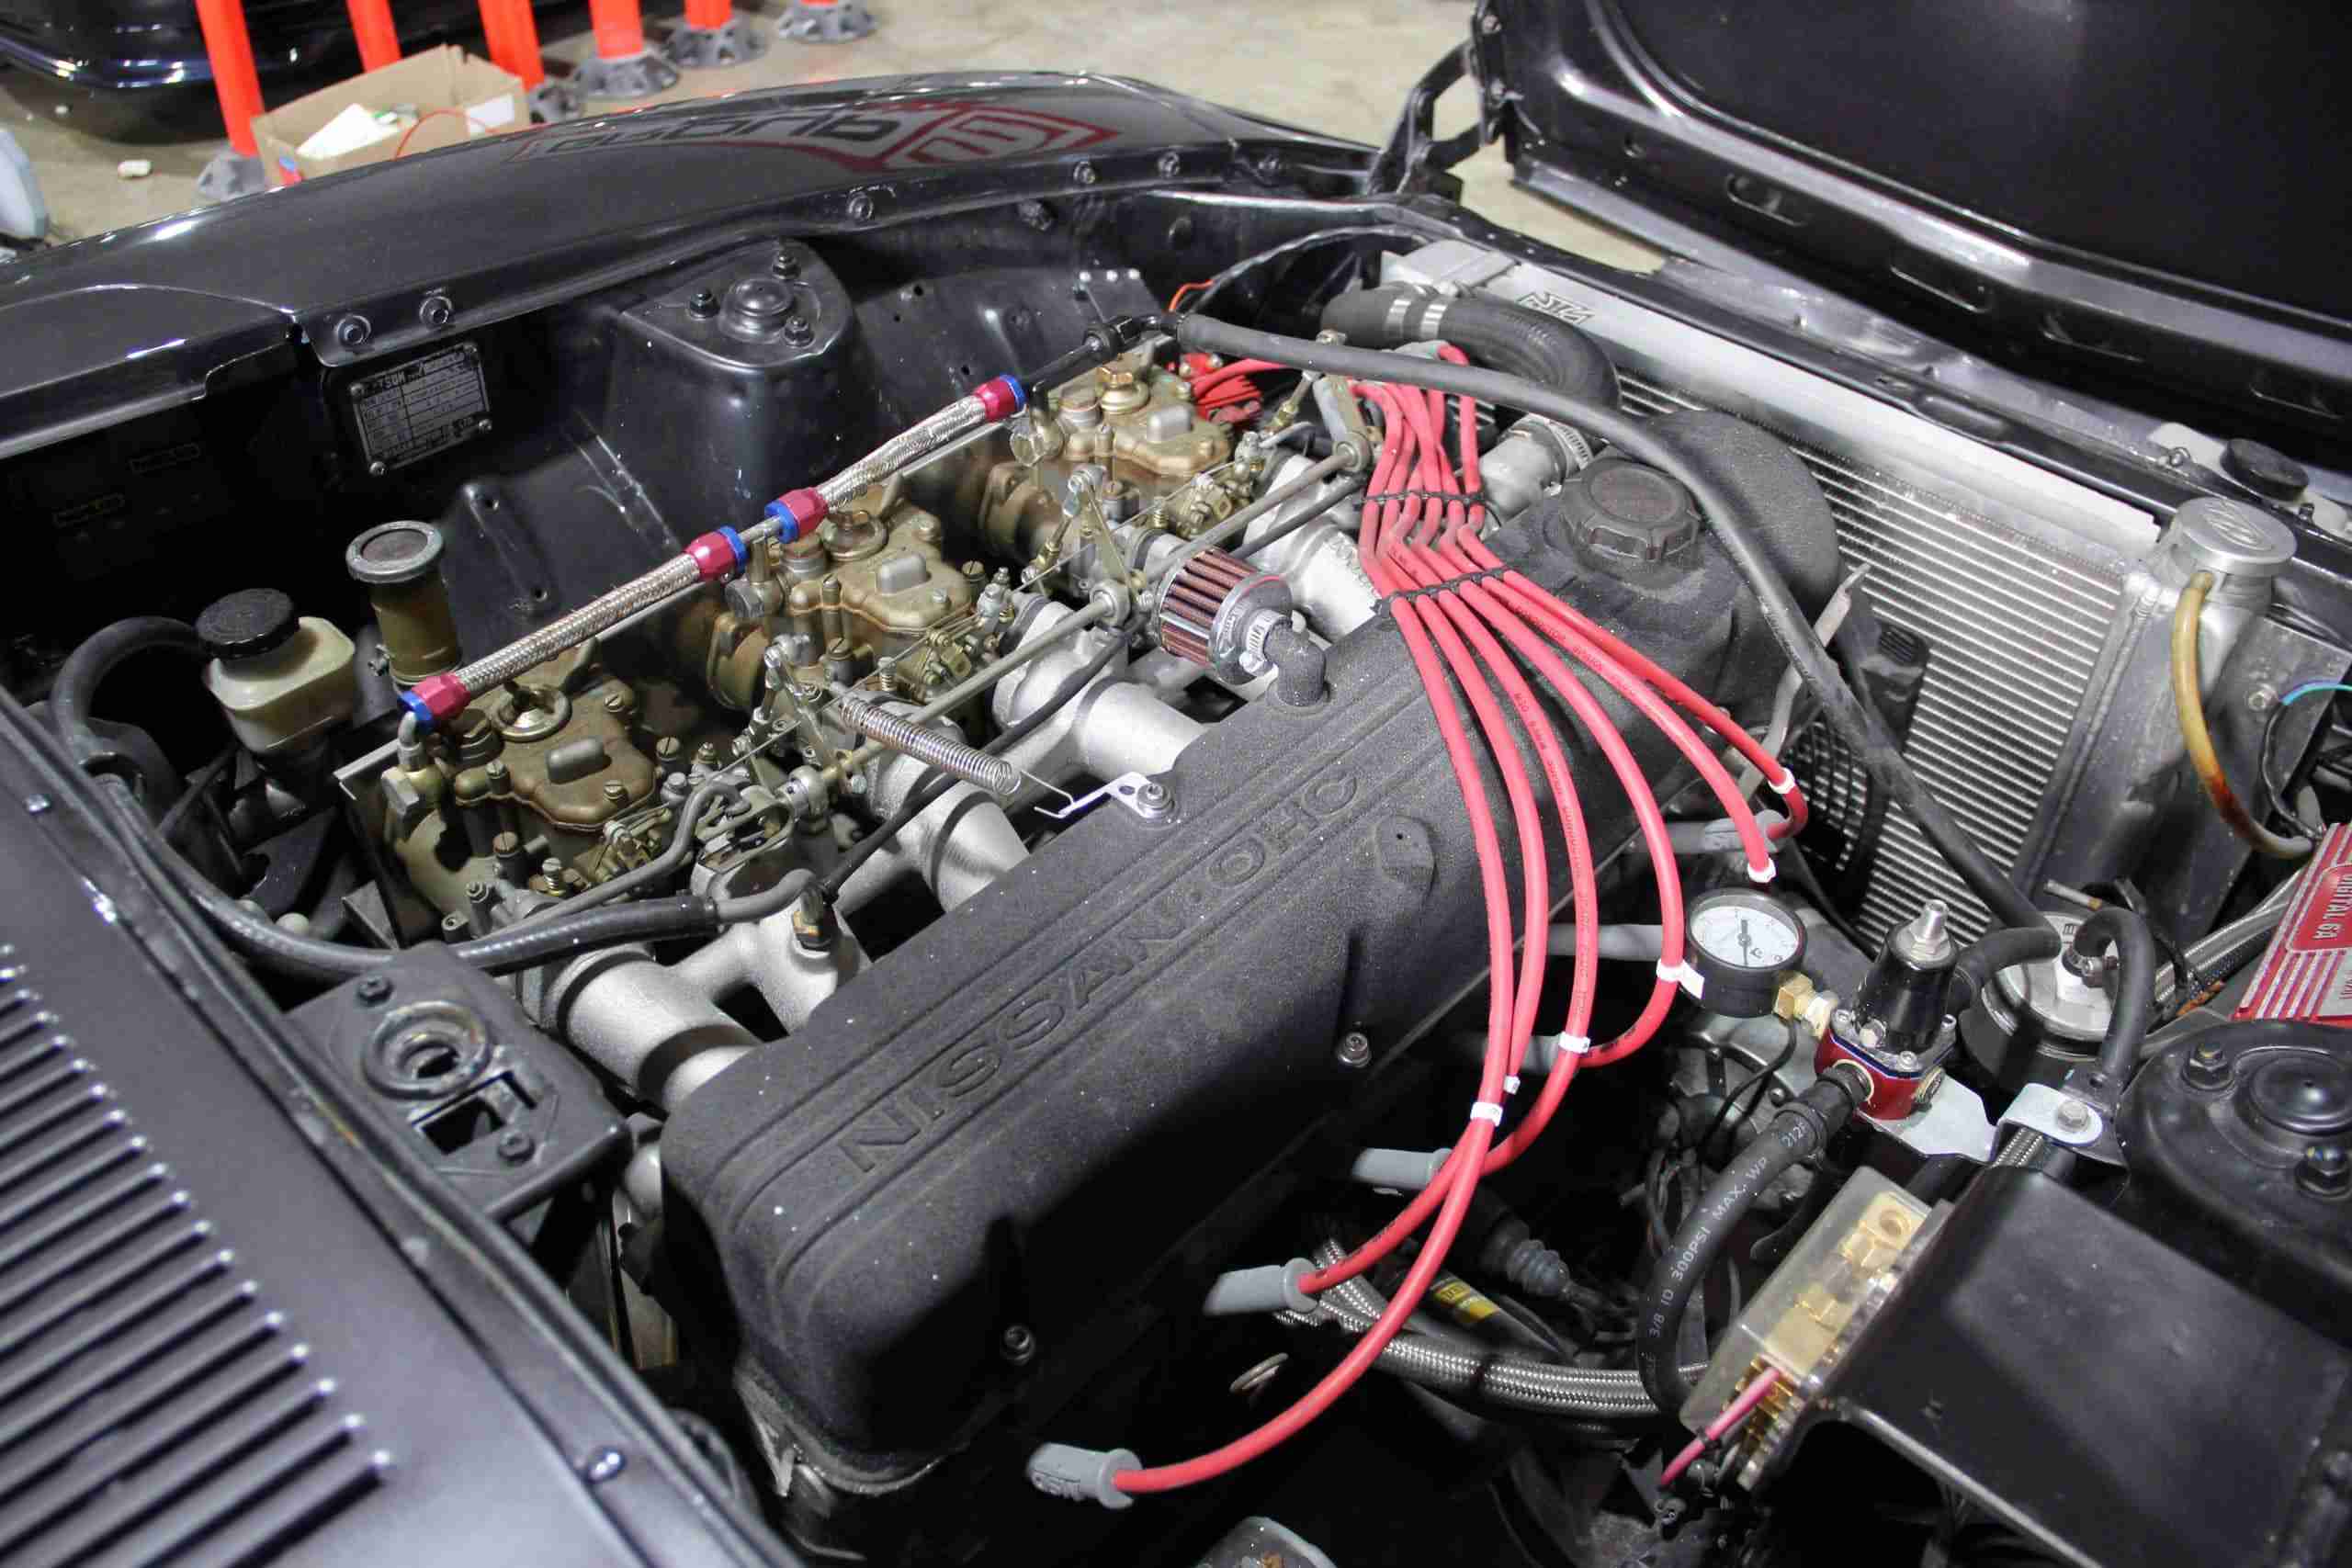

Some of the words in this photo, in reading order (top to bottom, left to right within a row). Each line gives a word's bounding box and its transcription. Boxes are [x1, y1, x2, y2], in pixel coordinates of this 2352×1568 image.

[836, 893, 1187, 1173] NISSAN
[1205, 769, 1358, 888] OHC
[1670, 1226, 1713, 1281] 300PSI
